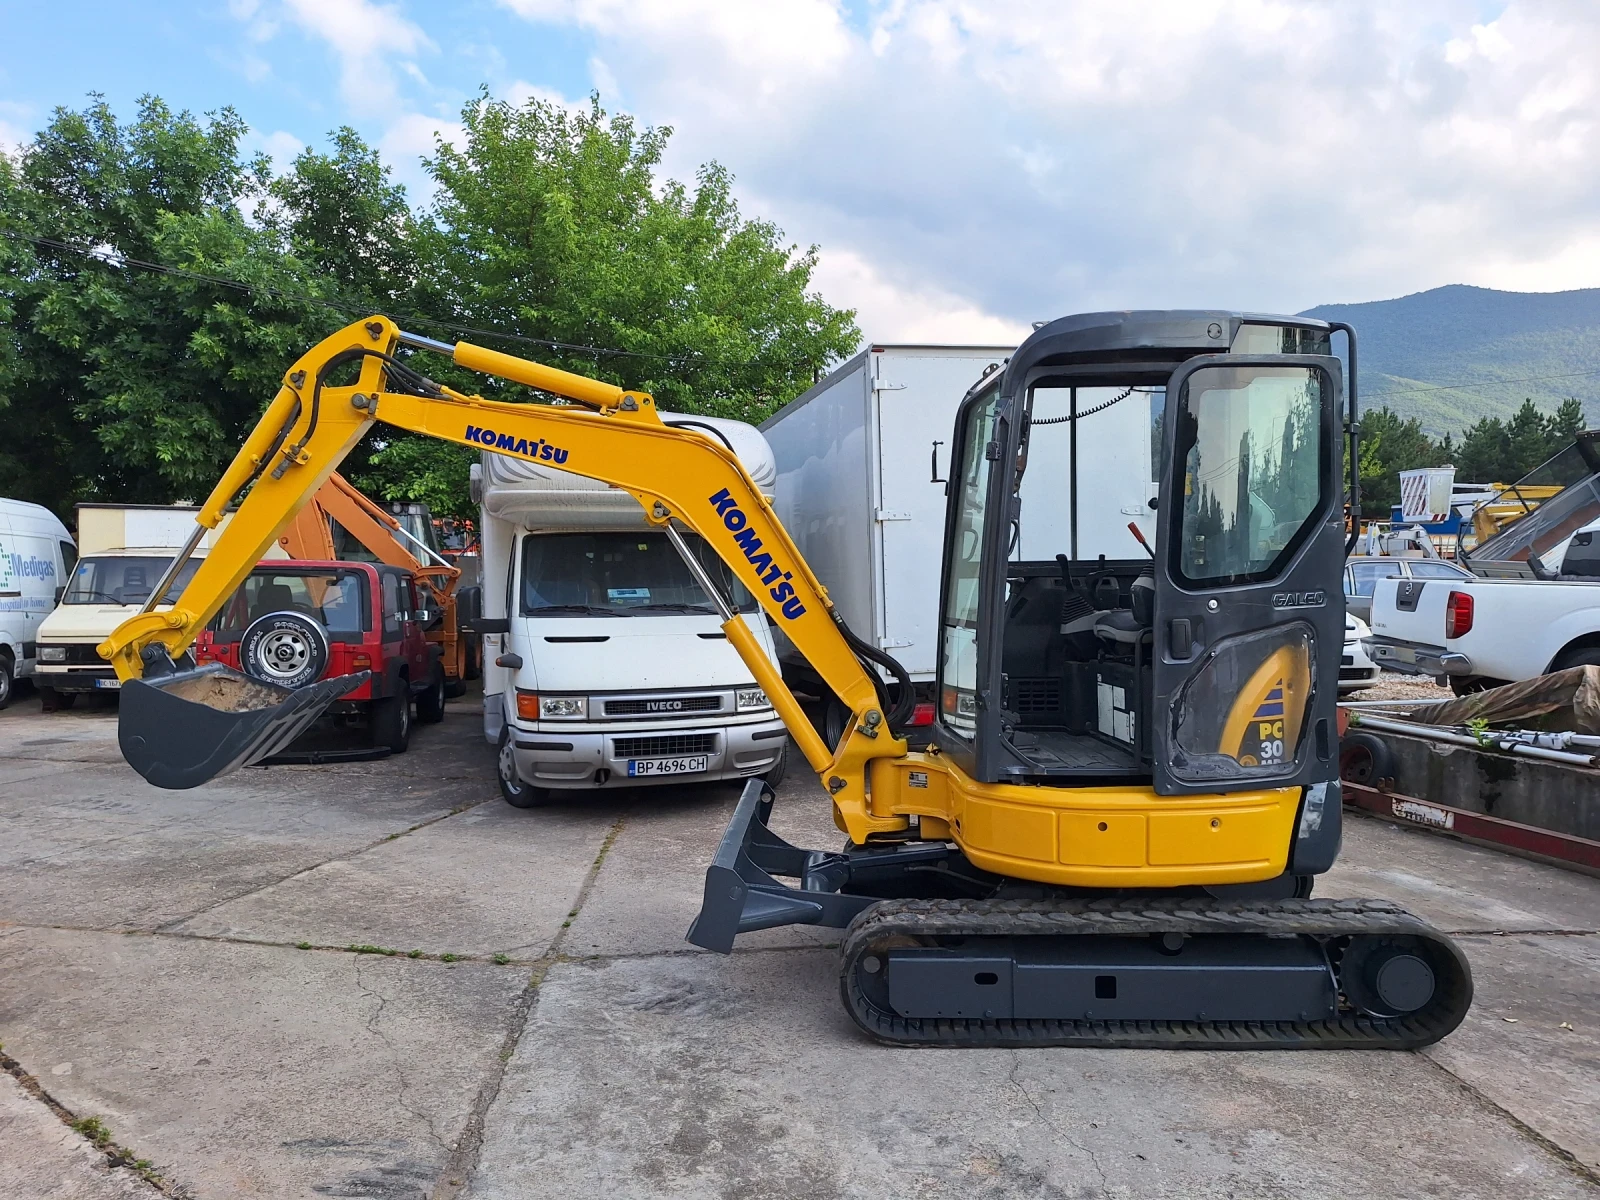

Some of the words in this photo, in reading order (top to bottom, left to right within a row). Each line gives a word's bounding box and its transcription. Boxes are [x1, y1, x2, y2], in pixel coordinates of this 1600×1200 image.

[465, 425, 569, 464] KOMATSU
[708, 487, 807, 620] KOMATSU
[10, 553, 55, 581] Medigas
[646, 701, 682, 711] IVECO
[1259, 721, 1283, 740] PC
[1260, 740, 1283, 758] 30
[637, 762, 654, 774] BP
[656, 760, 686, 773] 4696
[688, 757, 705, 770] CH
